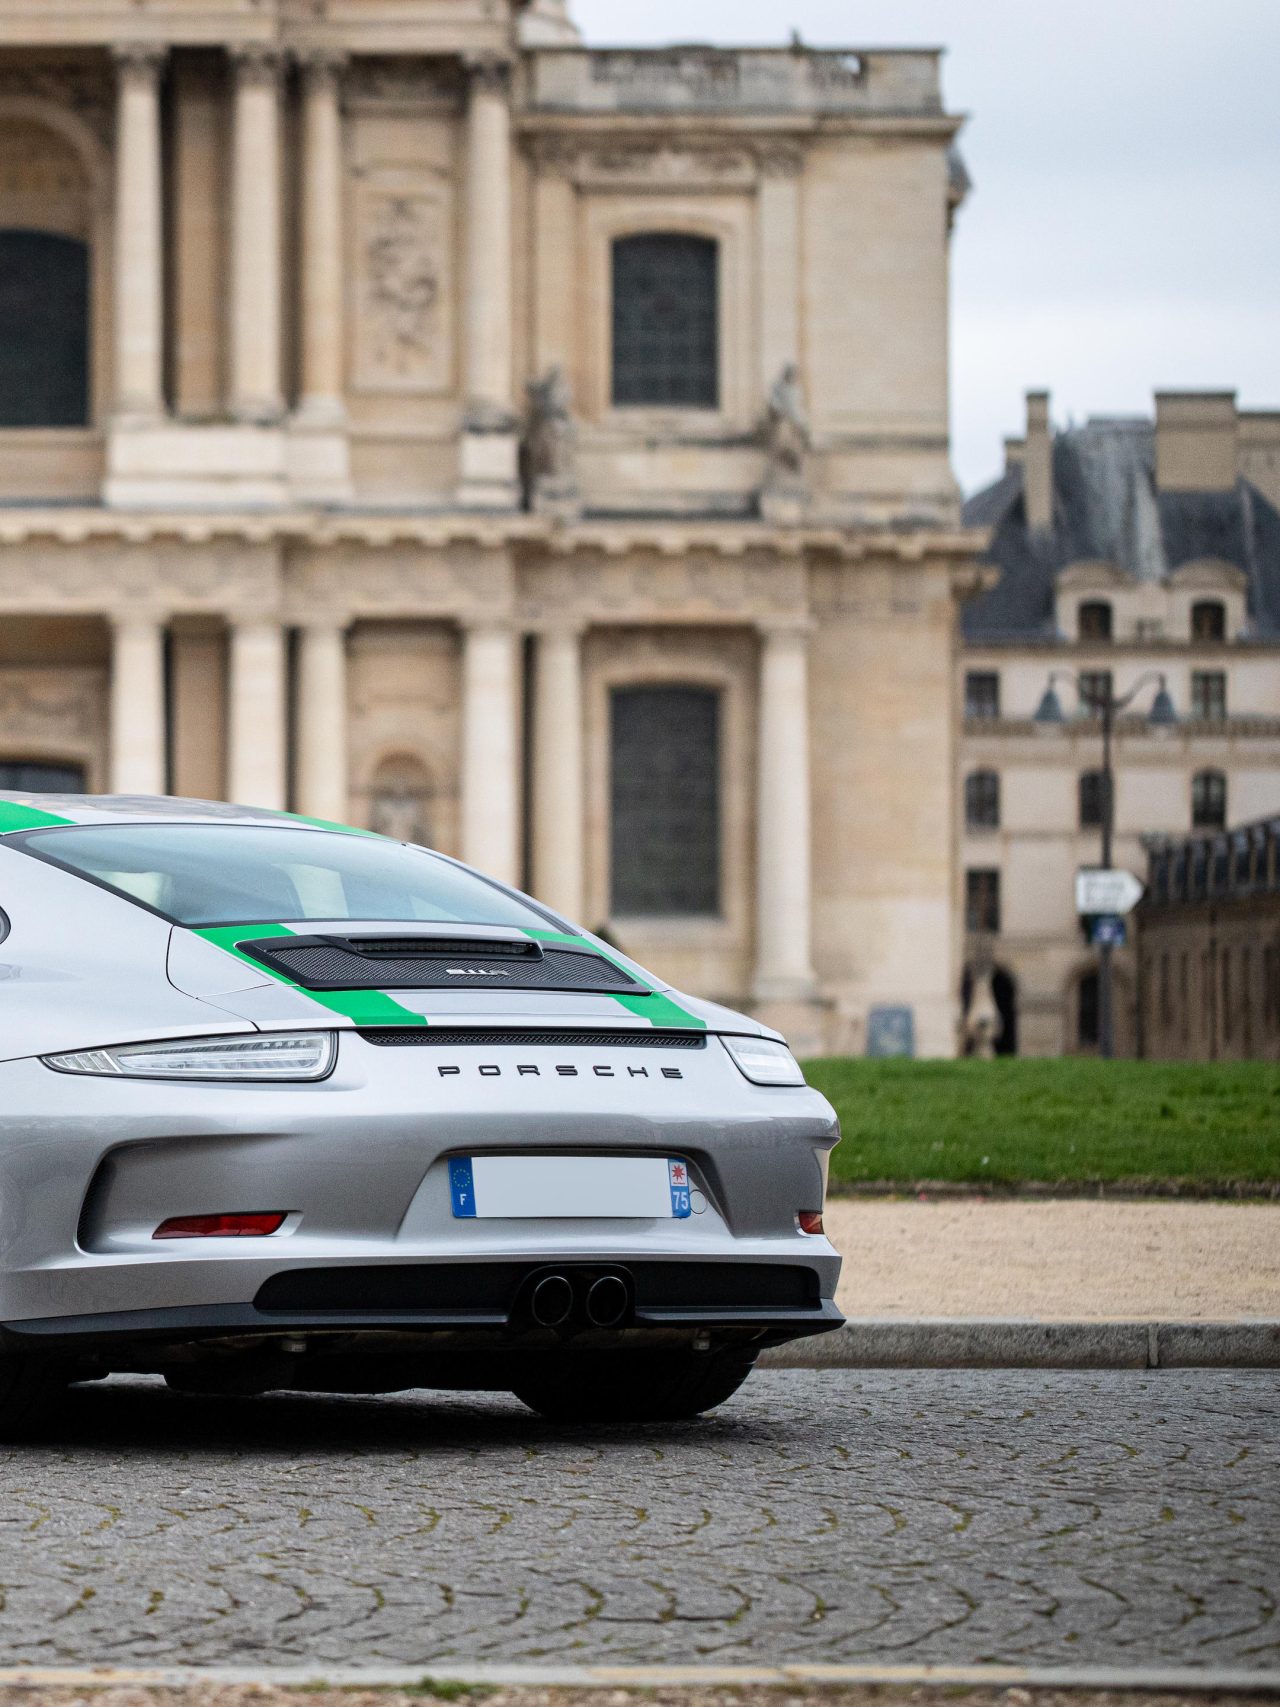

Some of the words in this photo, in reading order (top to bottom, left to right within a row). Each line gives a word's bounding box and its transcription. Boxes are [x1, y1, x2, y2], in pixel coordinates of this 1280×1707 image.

[437, 1064, 683, 1079] PORSCHE
[460, 1193, 467, 1206] F
[672, 1191, 689, 1210] 75
